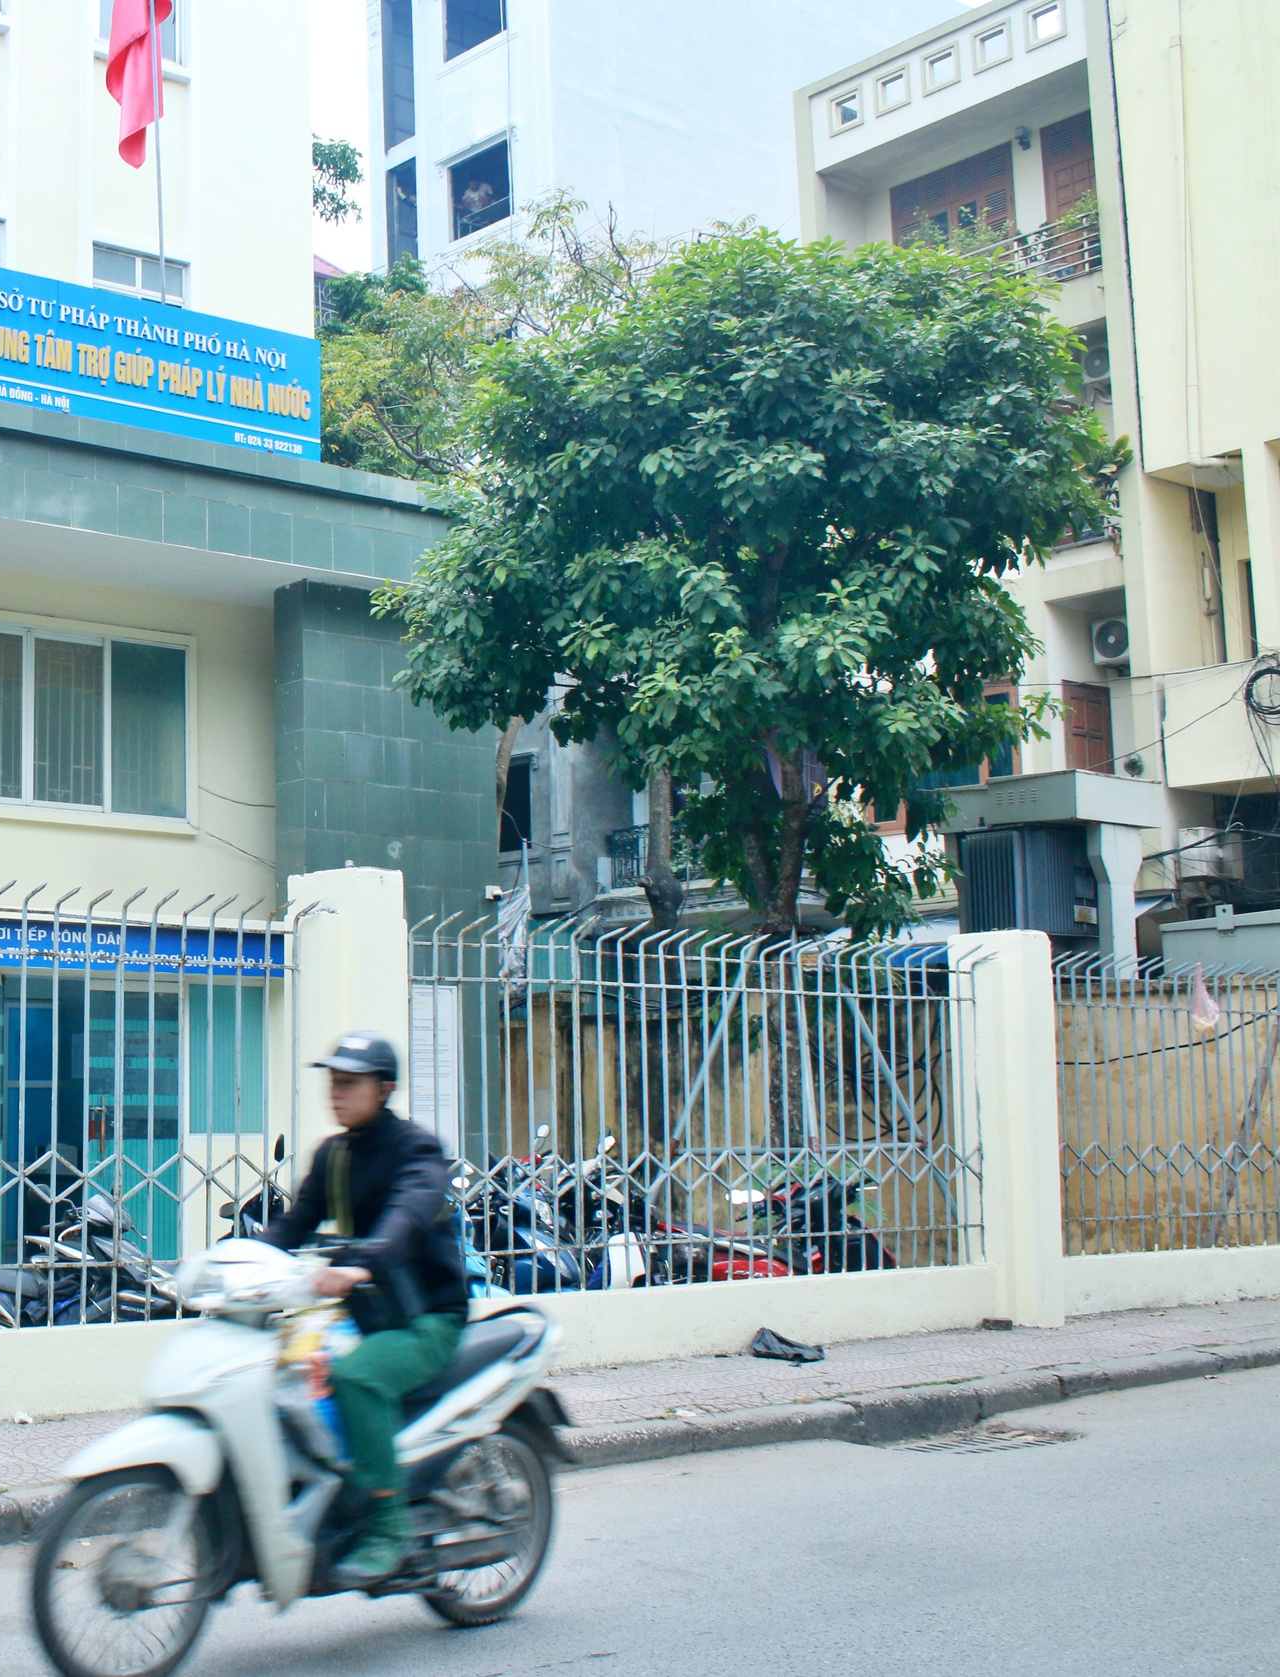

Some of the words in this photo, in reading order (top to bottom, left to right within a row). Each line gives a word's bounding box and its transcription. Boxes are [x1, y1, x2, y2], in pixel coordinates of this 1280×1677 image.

[27, 297, 56, 318] TƯ
[59, 305, 110, 331] PHÁP
[113, 316, 179, 346] THÀNH
[183, 332, 221, 355] PHỐ
[225, 339, 251, 362] HÀ
[255, 347, 287, 372] NỘI
[34, 329, 72, 373] TÂM
[77, 343, 111, 386] TRỢ
[114, 348, 154, 388] GIÚP
[158, 358, 203, 398] PHÁP
[207, 365, 226, 403] LÝ
[230, 373, 264, 412] NHÀ
[268, 379, 311, 421] NƯỚC
[9, 388, 33, 402] ĐÔNG
[41, 392, 53, 406] HÀ
[55, 396, 70, 410] NỘI
[234, 432, 246, 443] ĐT:
[247, 435, 262, 447] 024
[263, 438, 273, 449] 33
[274, 440, 302, 455] 822130
[15, 926, 47, 941] TẾP
[184, 954, 215, 967] GIÚ
